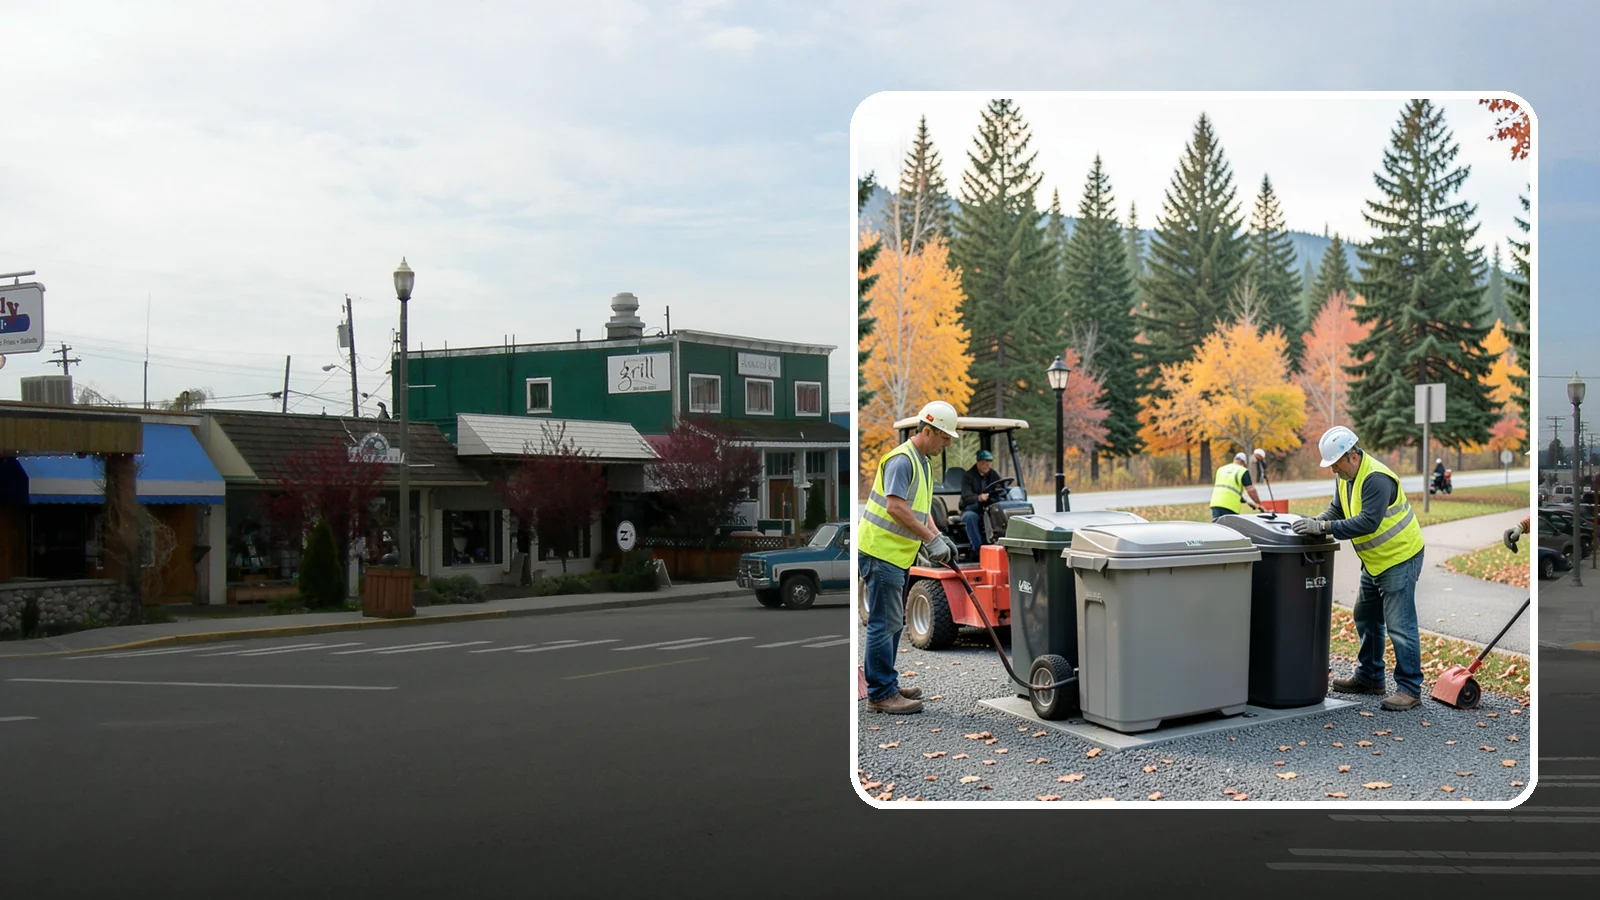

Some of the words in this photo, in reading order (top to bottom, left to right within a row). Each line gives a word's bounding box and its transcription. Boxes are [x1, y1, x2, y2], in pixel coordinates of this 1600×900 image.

[4, 338, 16, 346] Fries
[20, 336, 38, 345] Salads
[618, 356, 654, 391] grill
